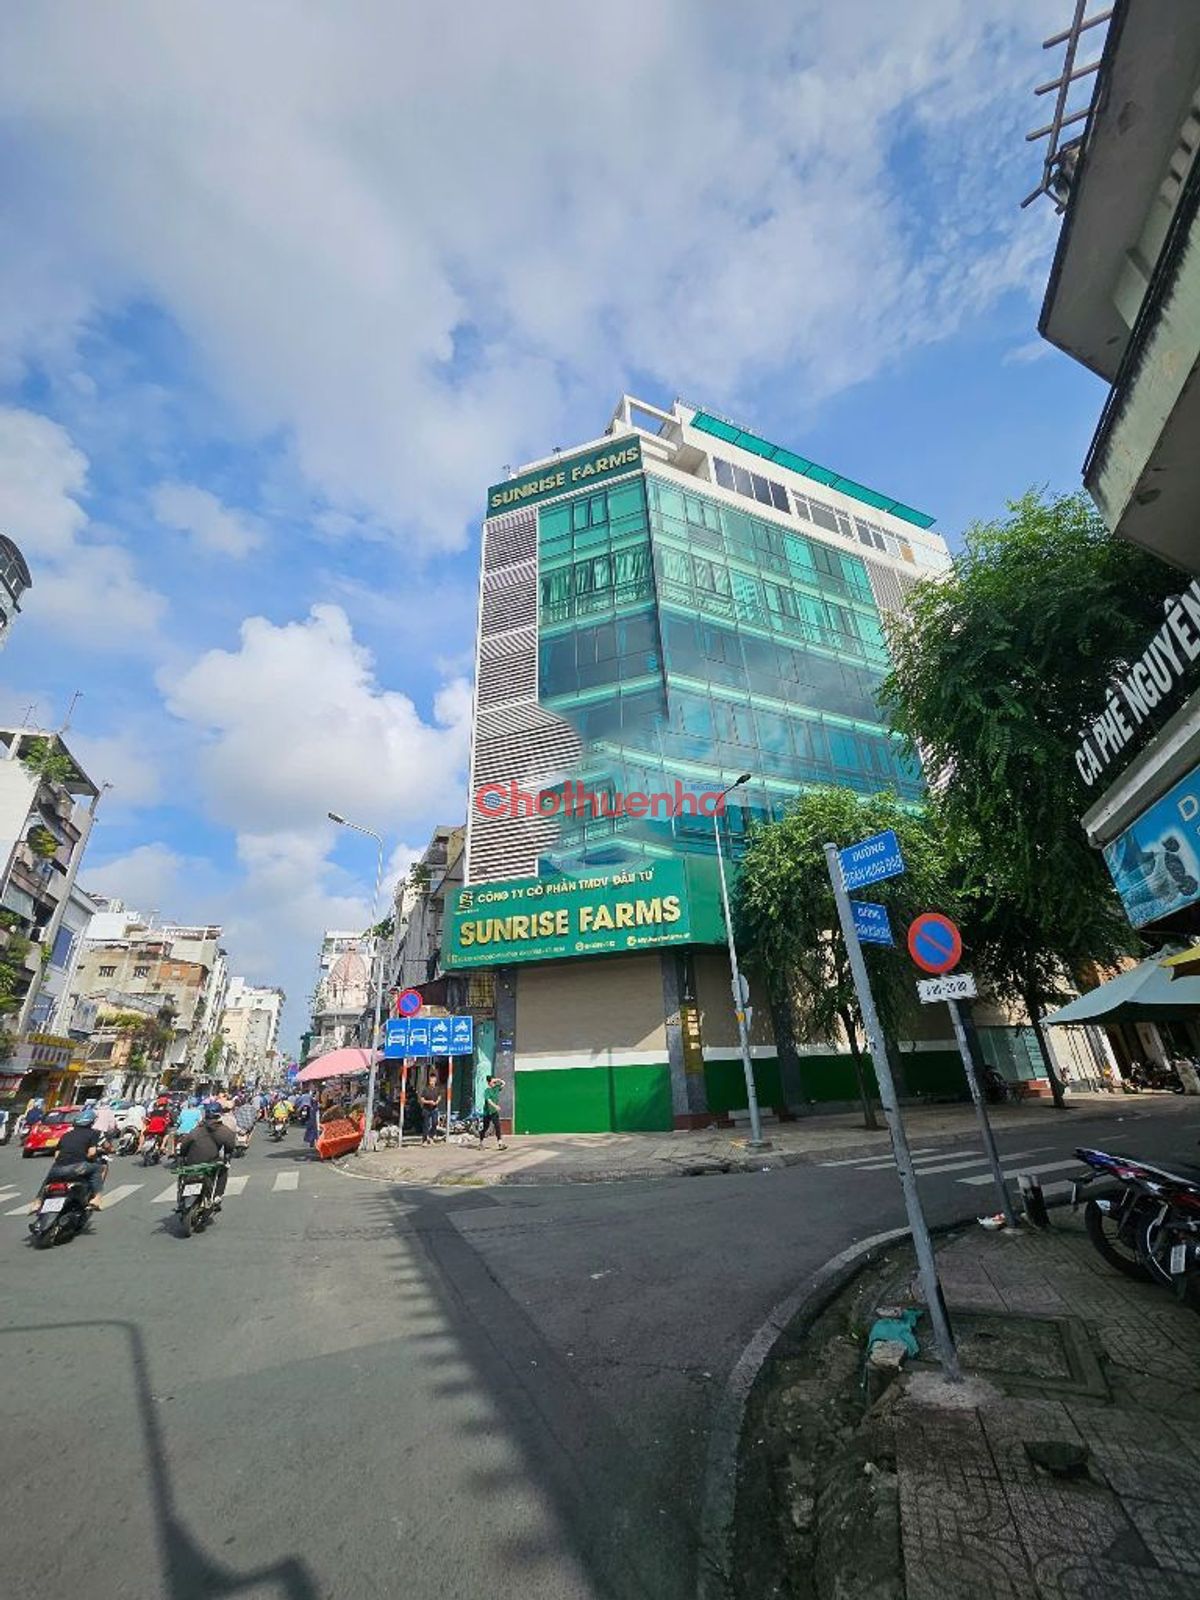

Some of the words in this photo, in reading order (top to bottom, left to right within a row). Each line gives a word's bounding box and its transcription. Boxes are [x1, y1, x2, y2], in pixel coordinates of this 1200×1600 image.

[491, 472, 566, 508] SUNRISE
[572, 446, 639, 482] FARMS
[1074, 730, 1103, 786] CÀ
[1092, 688, 1134, 764] PHÊ
[460, 909, 570, 945] SUNRISE
[578, 895, 681, 933] FARMS
[477, 891, 509, 904] CÔNG
[511, 889, 524, 900] TY
